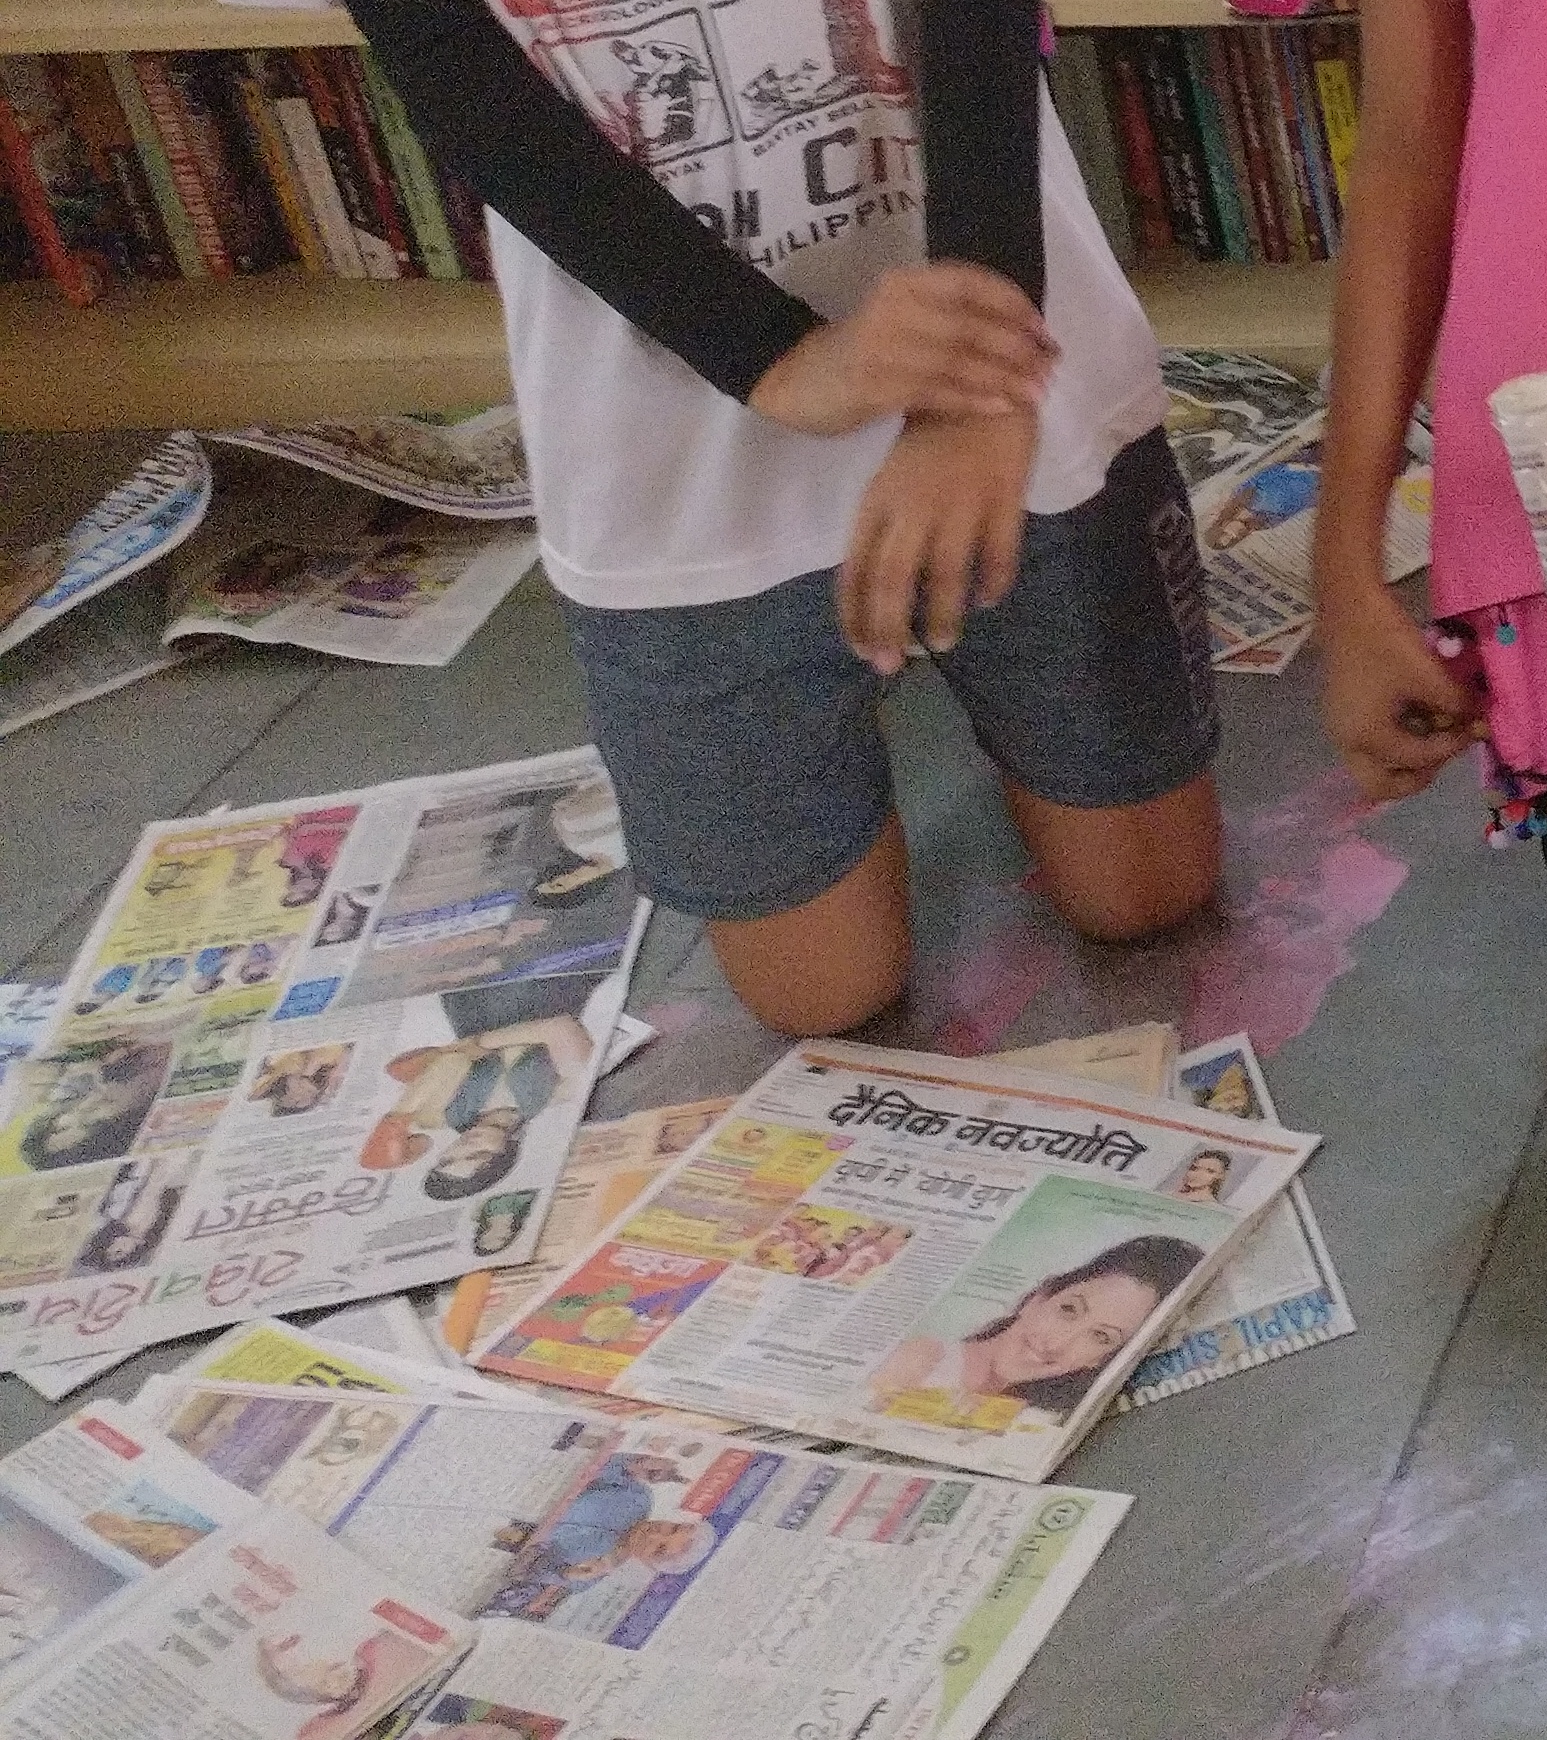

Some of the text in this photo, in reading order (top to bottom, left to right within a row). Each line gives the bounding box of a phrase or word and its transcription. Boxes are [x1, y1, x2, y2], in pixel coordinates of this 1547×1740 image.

[802, 126, 922, 207] CIT
[746, 190, 919, 267] HILIPPIN
[826, 1082, 1150, 1173] दैनिक नवज्योति
